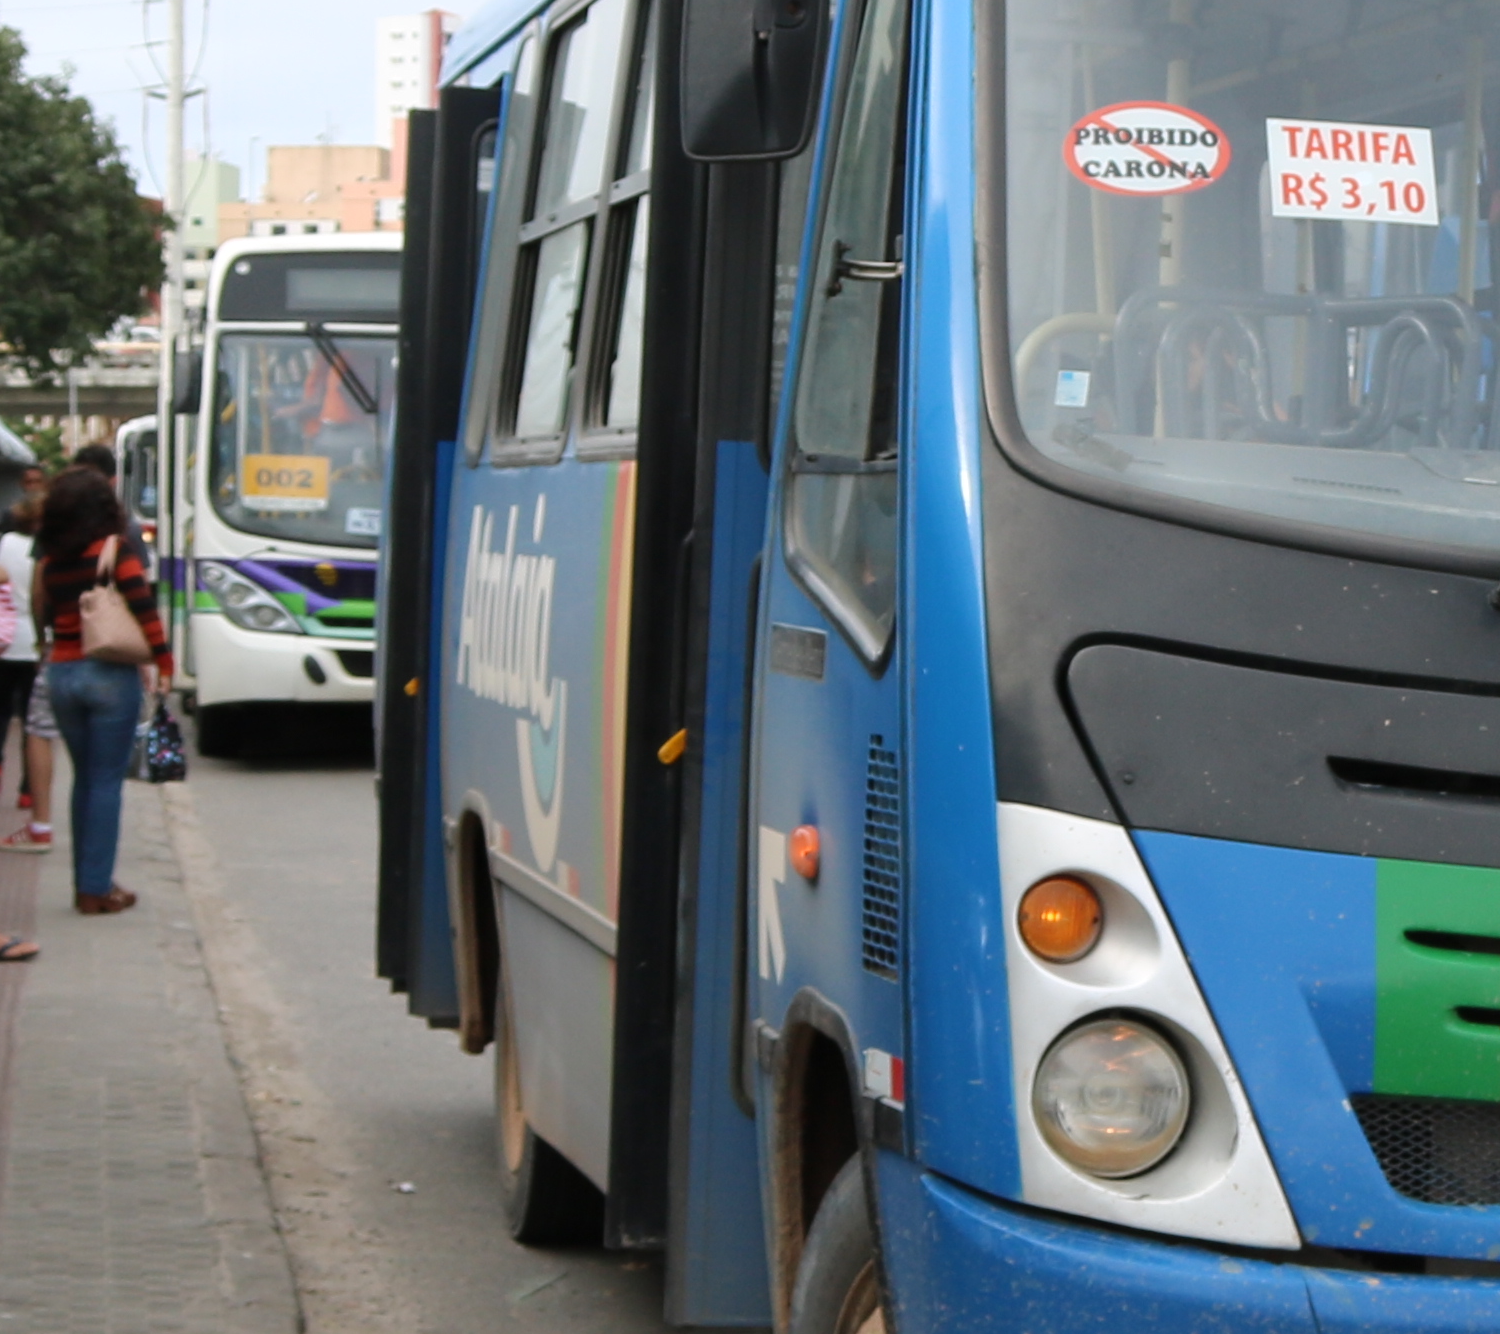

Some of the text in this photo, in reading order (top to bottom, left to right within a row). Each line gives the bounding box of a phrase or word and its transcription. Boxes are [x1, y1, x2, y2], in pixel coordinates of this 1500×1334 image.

[1074, 127, 1218, 148] PROIBIDO
[1281, 126, 1415, 165] TARIFA
[1083, 160, 1210, 179] CARONA
[1281, 173, 1425, 215] R$ 3,10
[256, 468, 313, 488] 002
